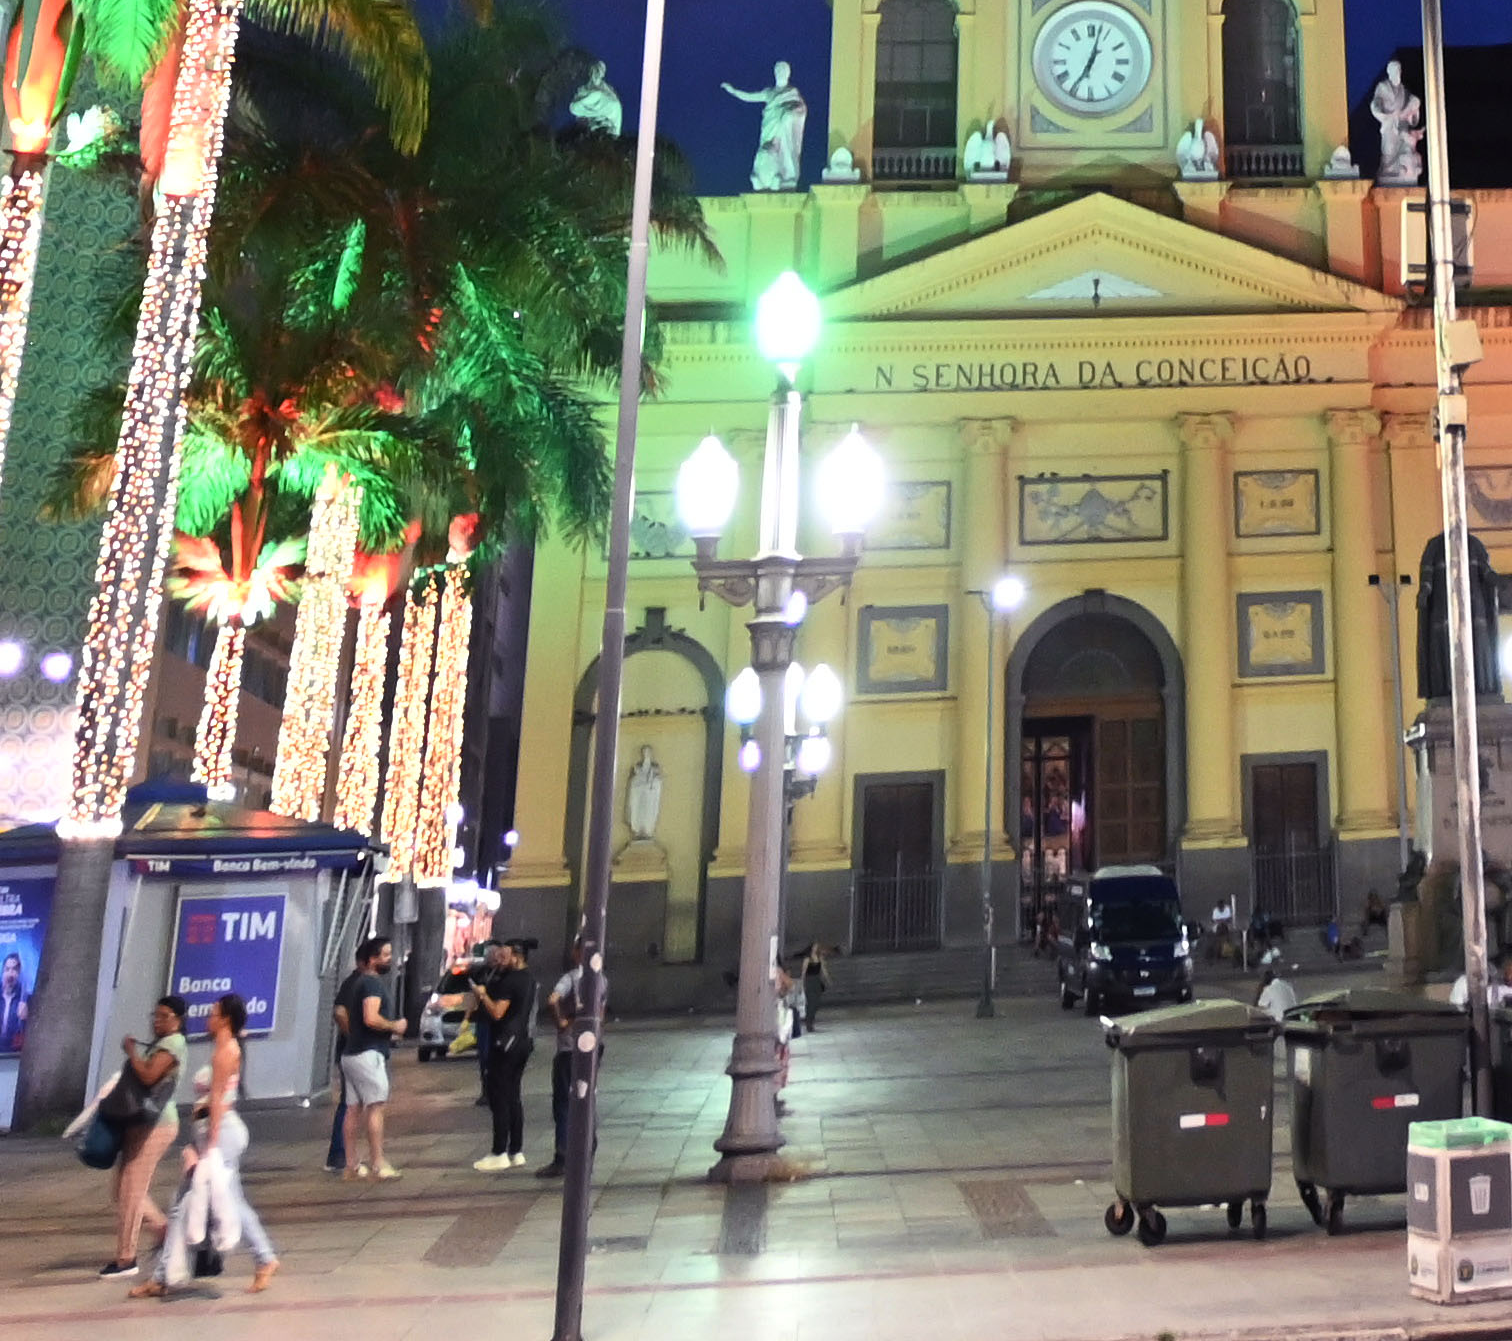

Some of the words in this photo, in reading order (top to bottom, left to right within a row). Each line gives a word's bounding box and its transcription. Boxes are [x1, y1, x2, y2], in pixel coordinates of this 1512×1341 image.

[874, 365, 894, 389] N
[912, 361, 1061, 391] SENHORA
[1078, 359, 1120, 388] DA
[1135, 352, 1312, 386] CONCEIÇÃO
[147, 859, 171, 872] TIM
[213, 859, 251, 873] Banca
[252, 857, 317, 872] Bem-vindo
[221, 910, 277, 942] TIM
[179, 976, 232, 994] Banca
